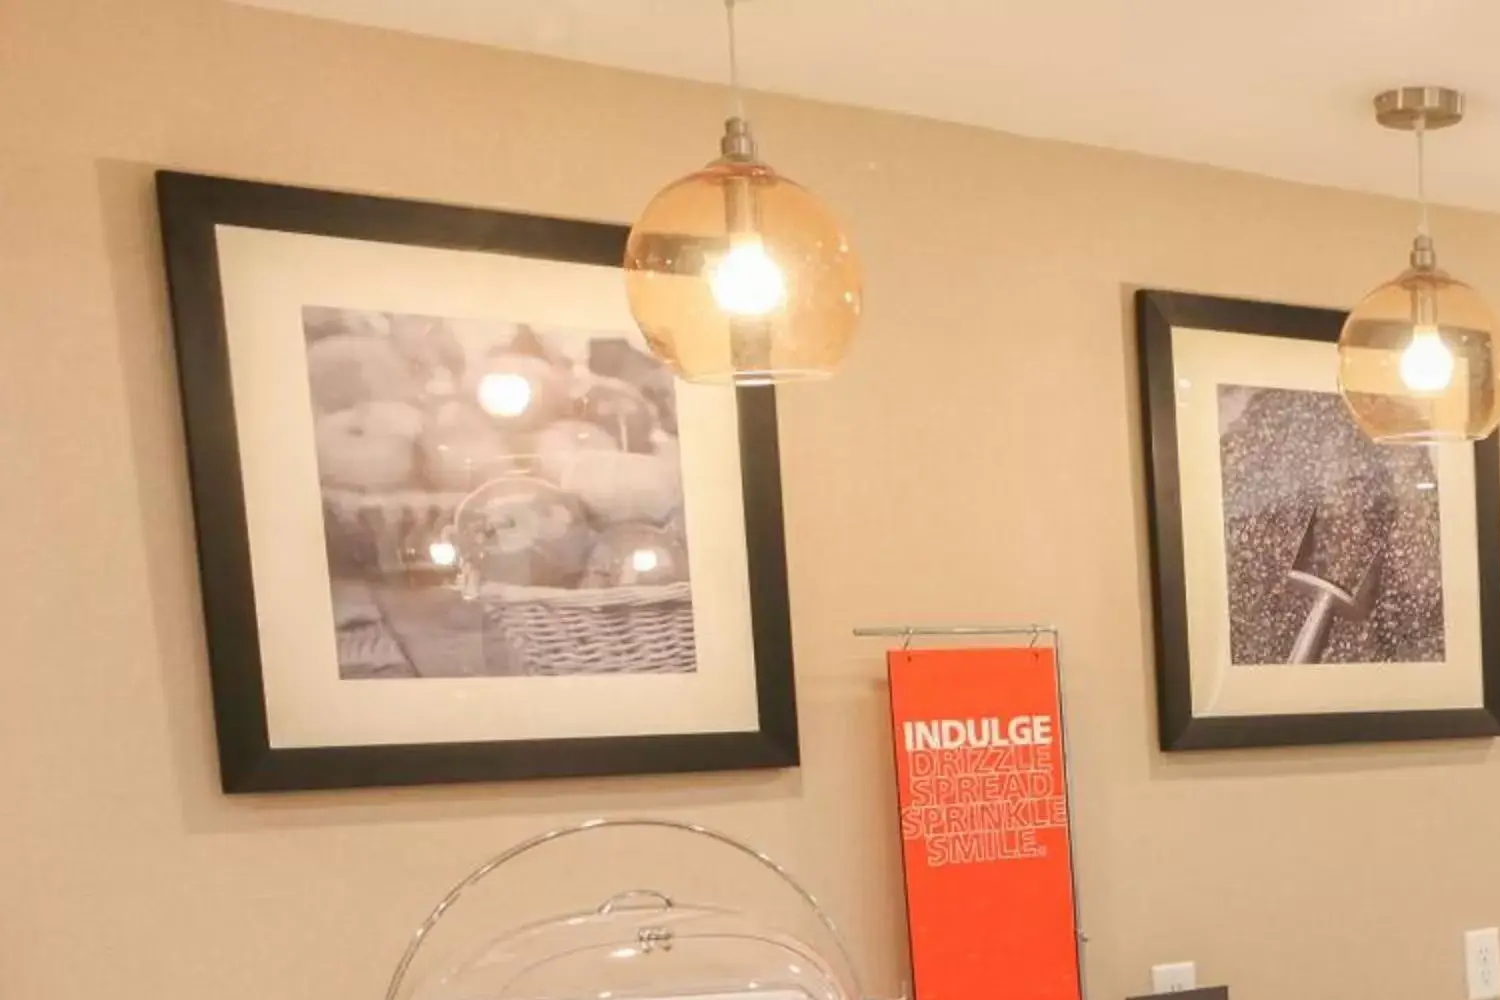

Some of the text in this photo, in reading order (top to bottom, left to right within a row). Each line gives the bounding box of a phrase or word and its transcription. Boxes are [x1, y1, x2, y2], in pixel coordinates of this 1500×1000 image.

[903, 715, 1053, 751] INDULGE
[910, 745, 1054, 778] DRIZZLE
[910, 772, 1054, 808] SPREAD
[900, 795, 1068, 841] SPRINKLE
[927, 827, 1047, 867] SMILE.
